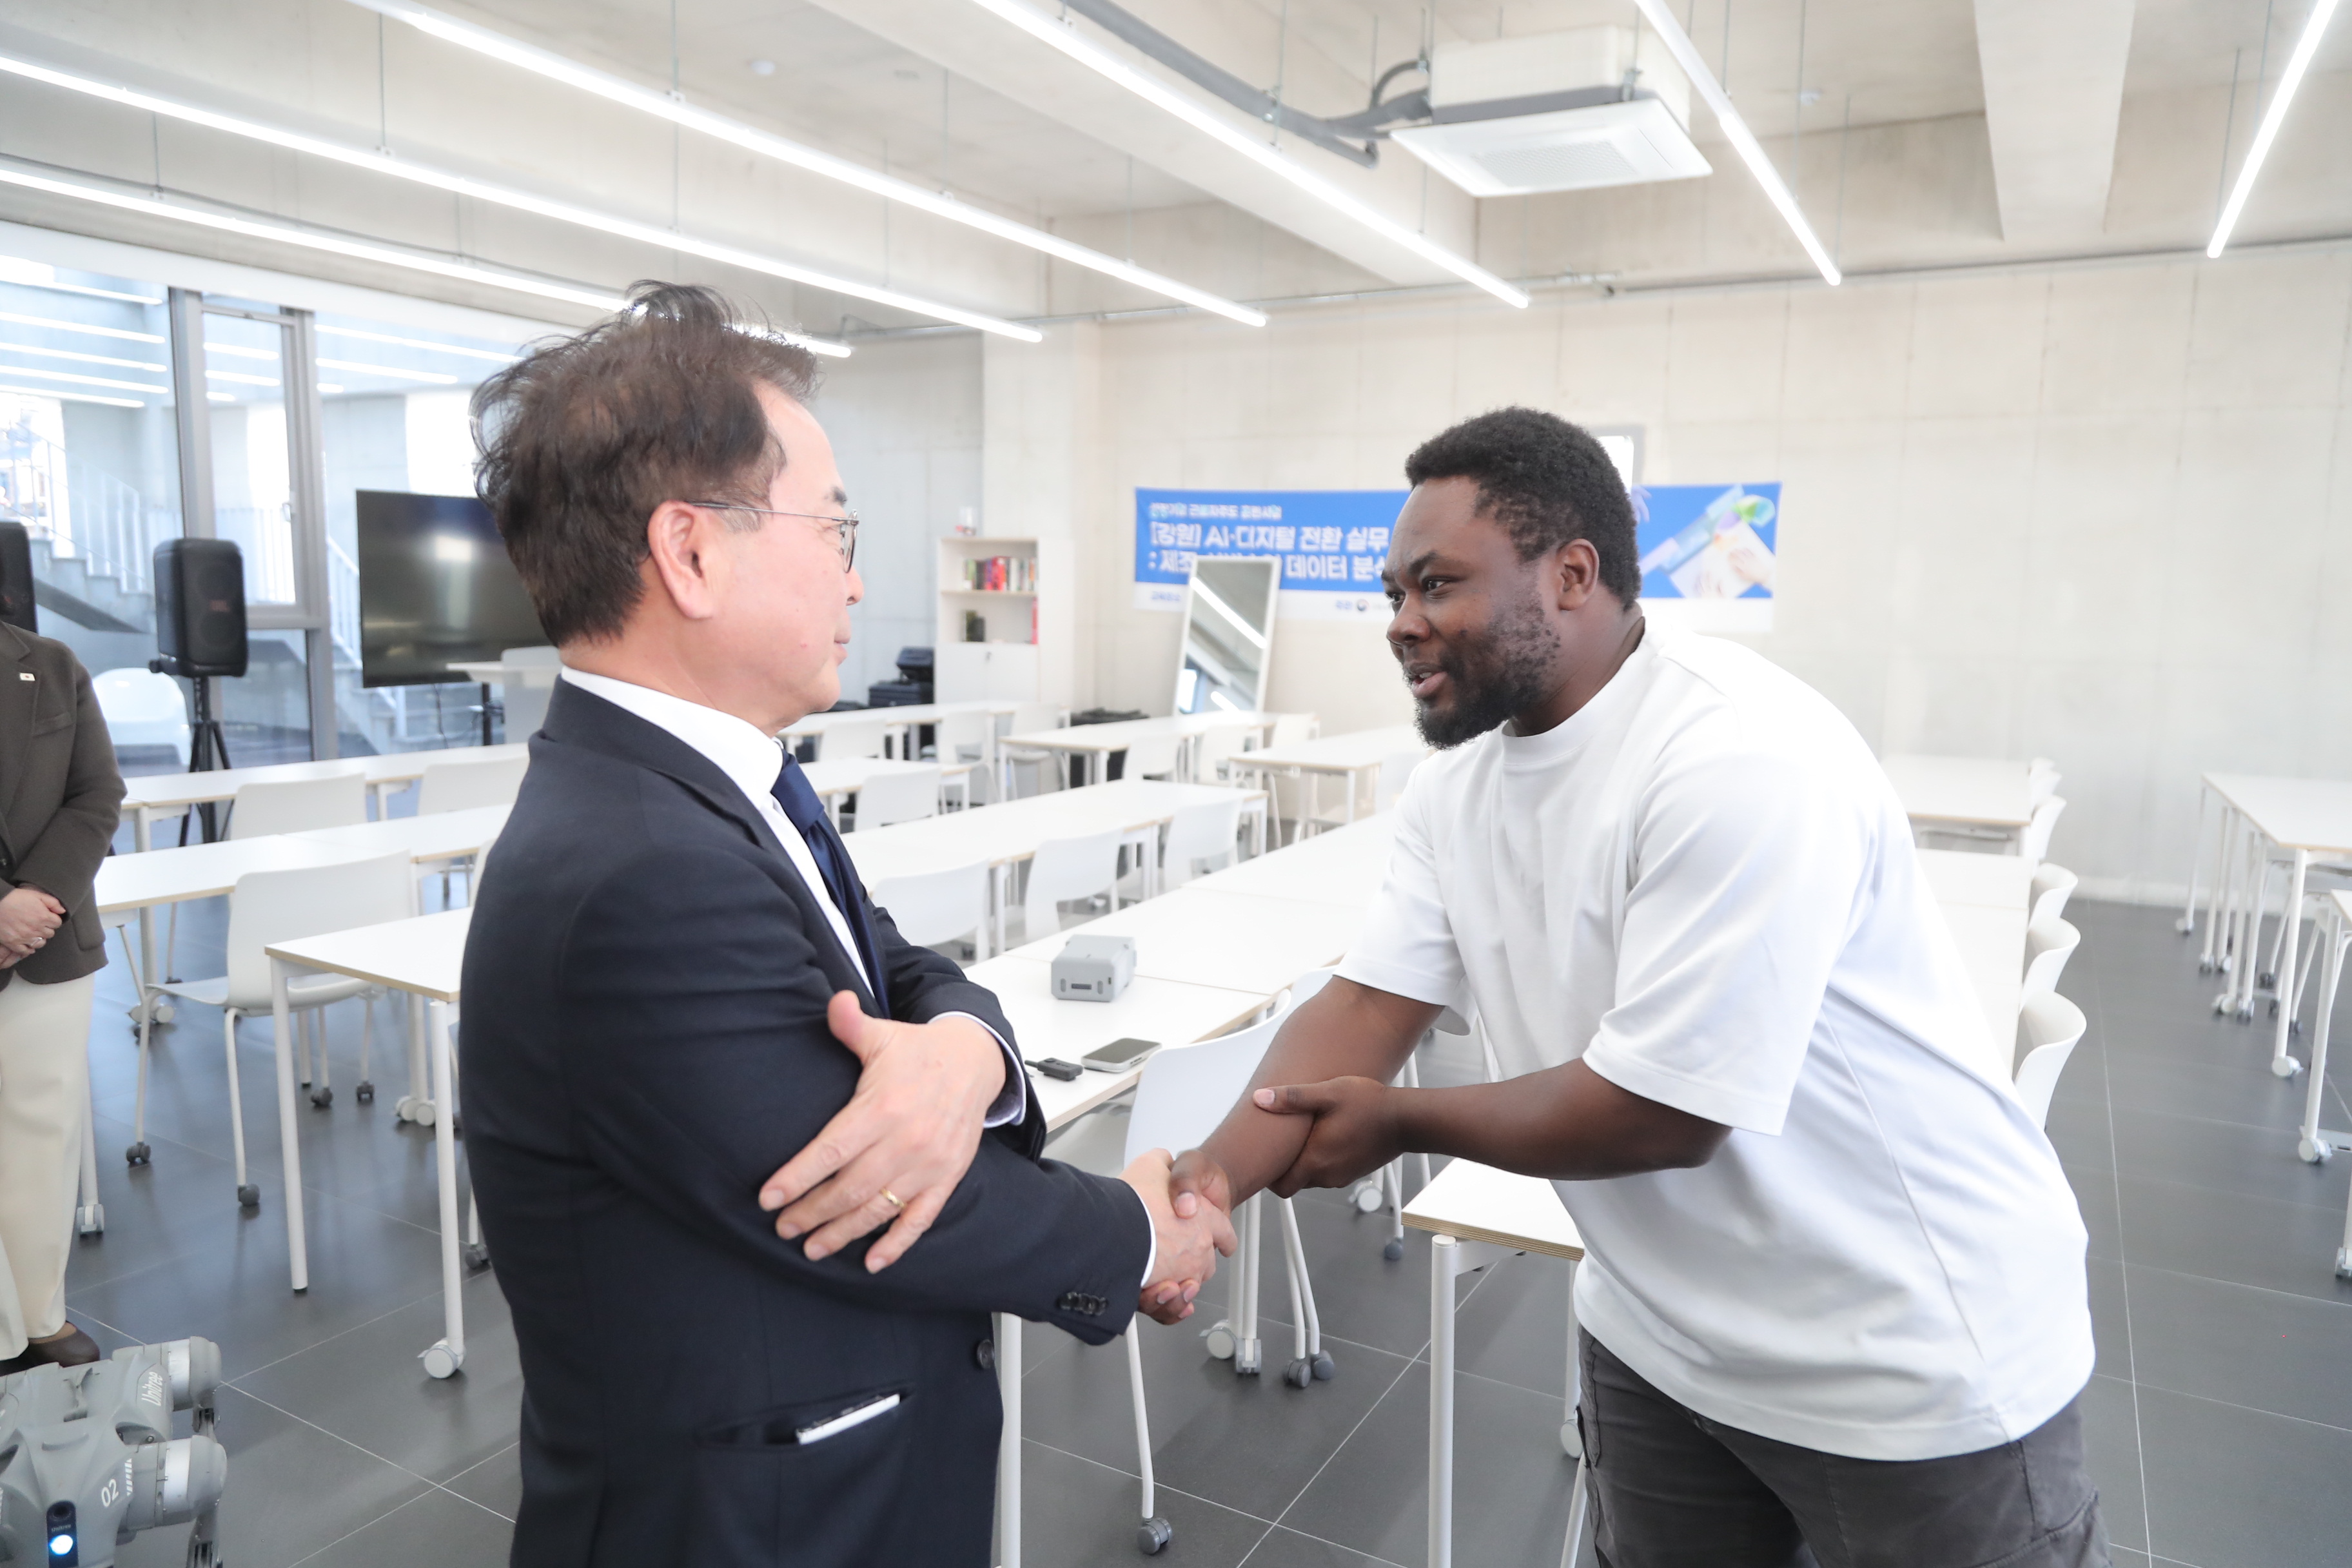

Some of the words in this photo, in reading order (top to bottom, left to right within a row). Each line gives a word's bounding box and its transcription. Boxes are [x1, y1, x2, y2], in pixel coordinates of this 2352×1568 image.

[1151, 521, 1202, 547] [강원]
[1300, 525, 1343, 552] 전환
[1346, 526, 1389, 553] 실무
[1286, 554, 1348, 580] 데이터
[141, 1371, 163, 1407] Unitree
[101, 1478, 119, 1507] 02
